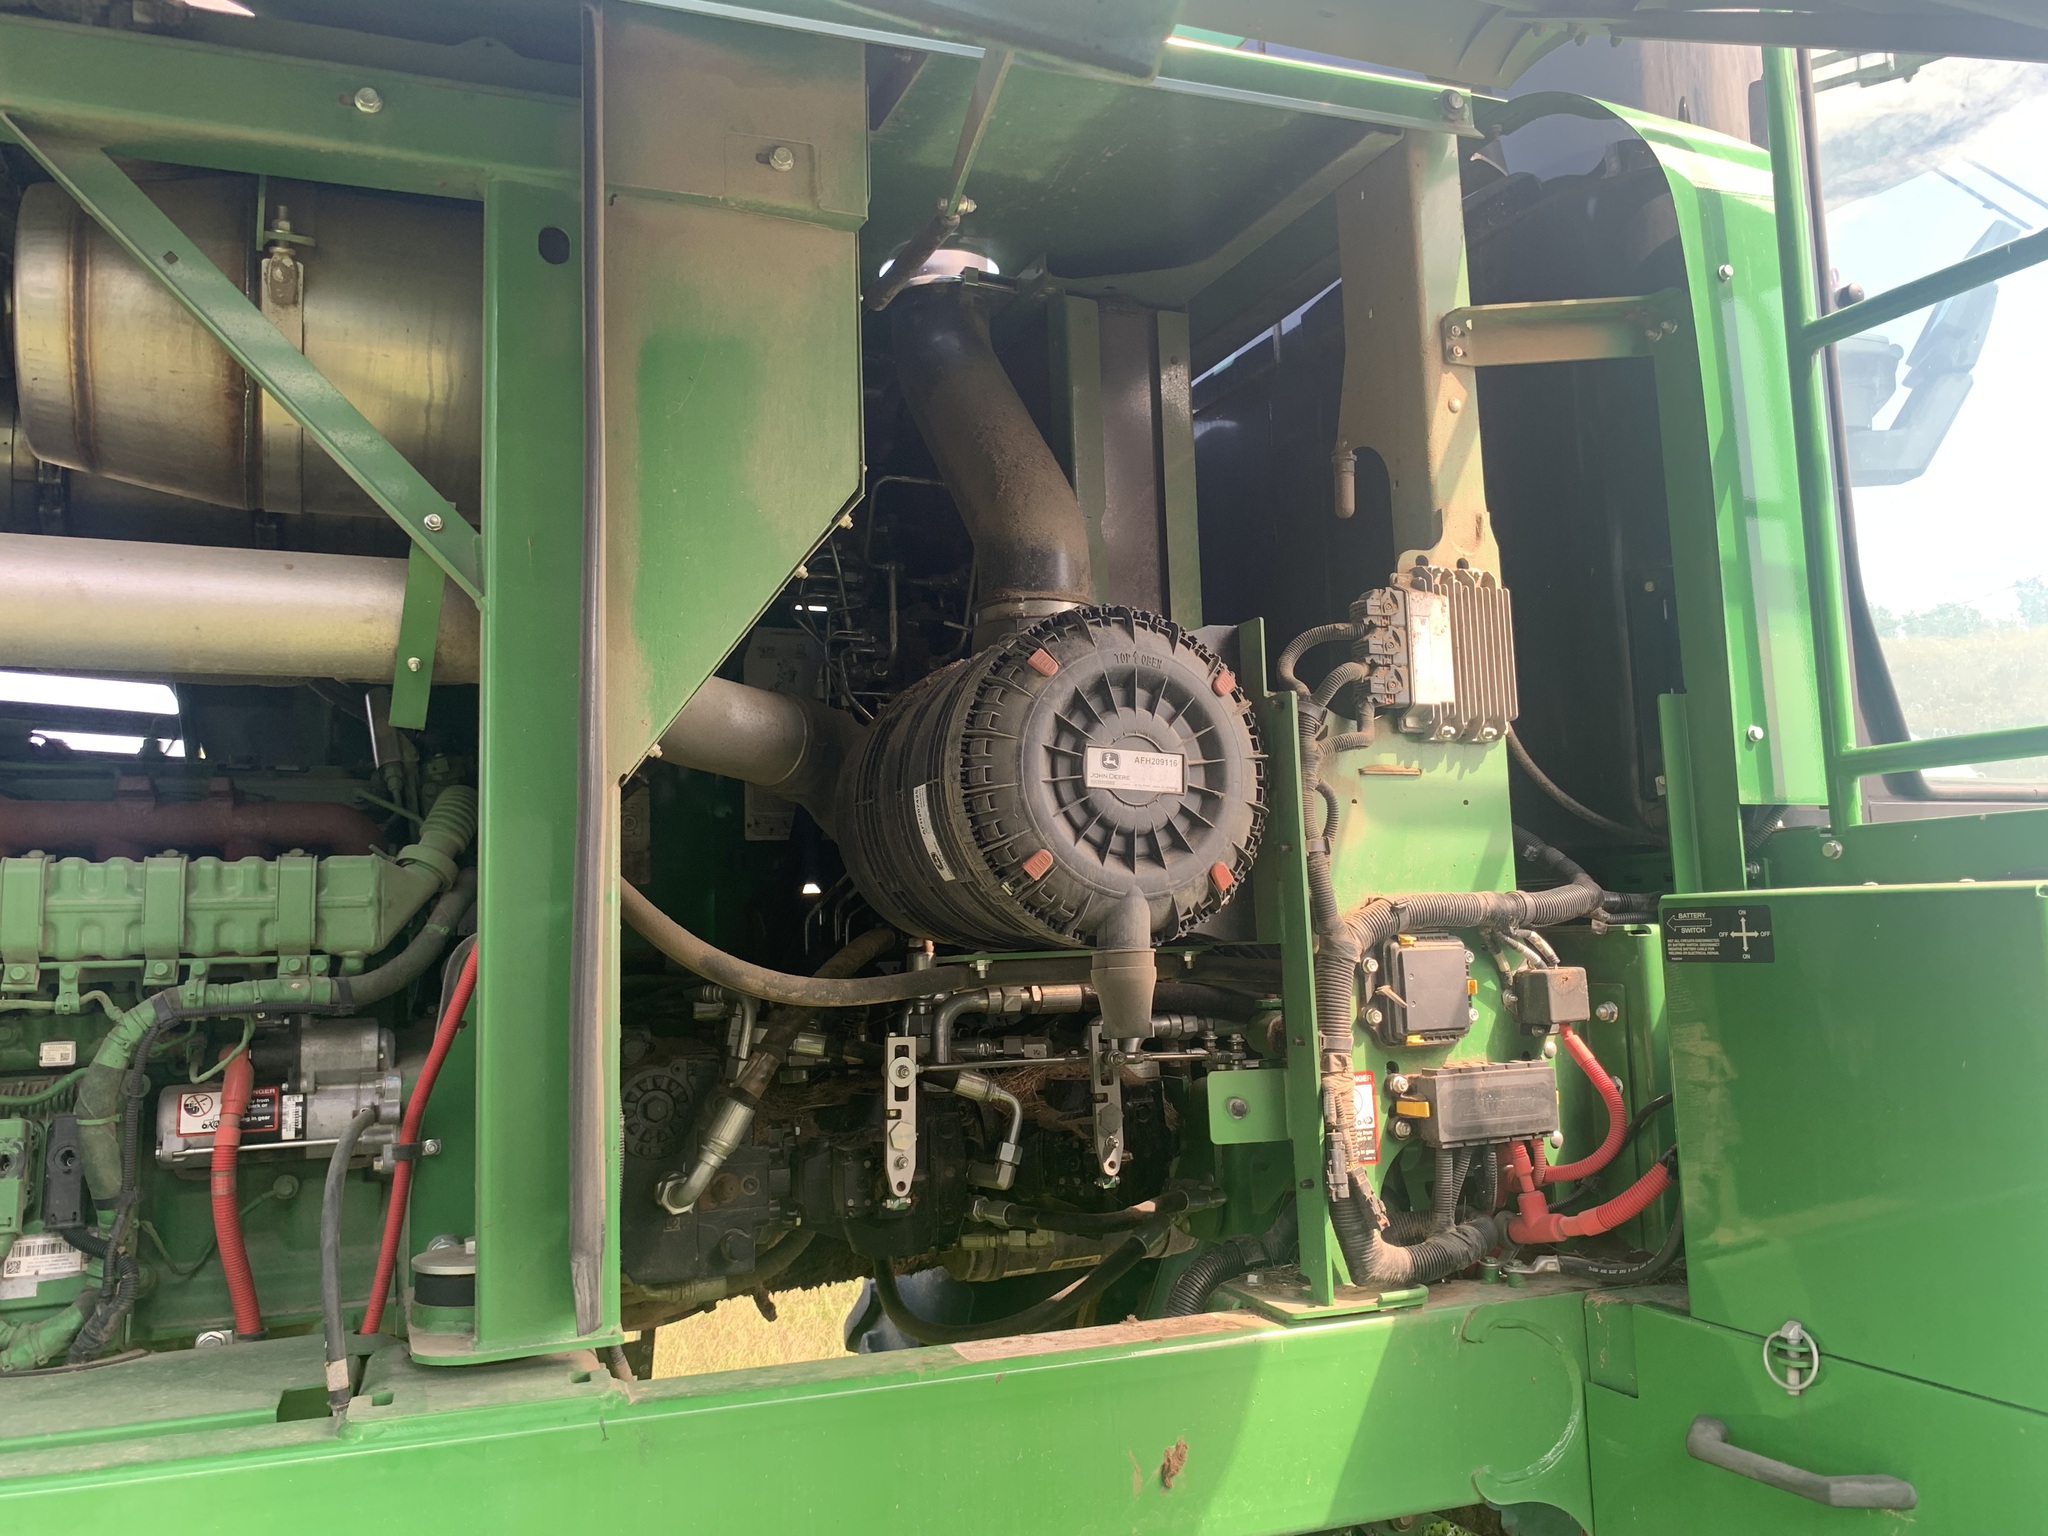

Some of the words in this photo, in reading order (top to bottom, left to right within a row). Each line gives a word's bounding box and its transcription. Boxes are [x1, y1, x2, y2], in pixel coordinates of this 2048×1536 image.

[1113, 652, 1131, 664] TOP
[1134, 756, 1178, 767] AFH209116
[1090, 772, 1108, 780] JOHN
[1109, 773, 1130, 781] DEERE
